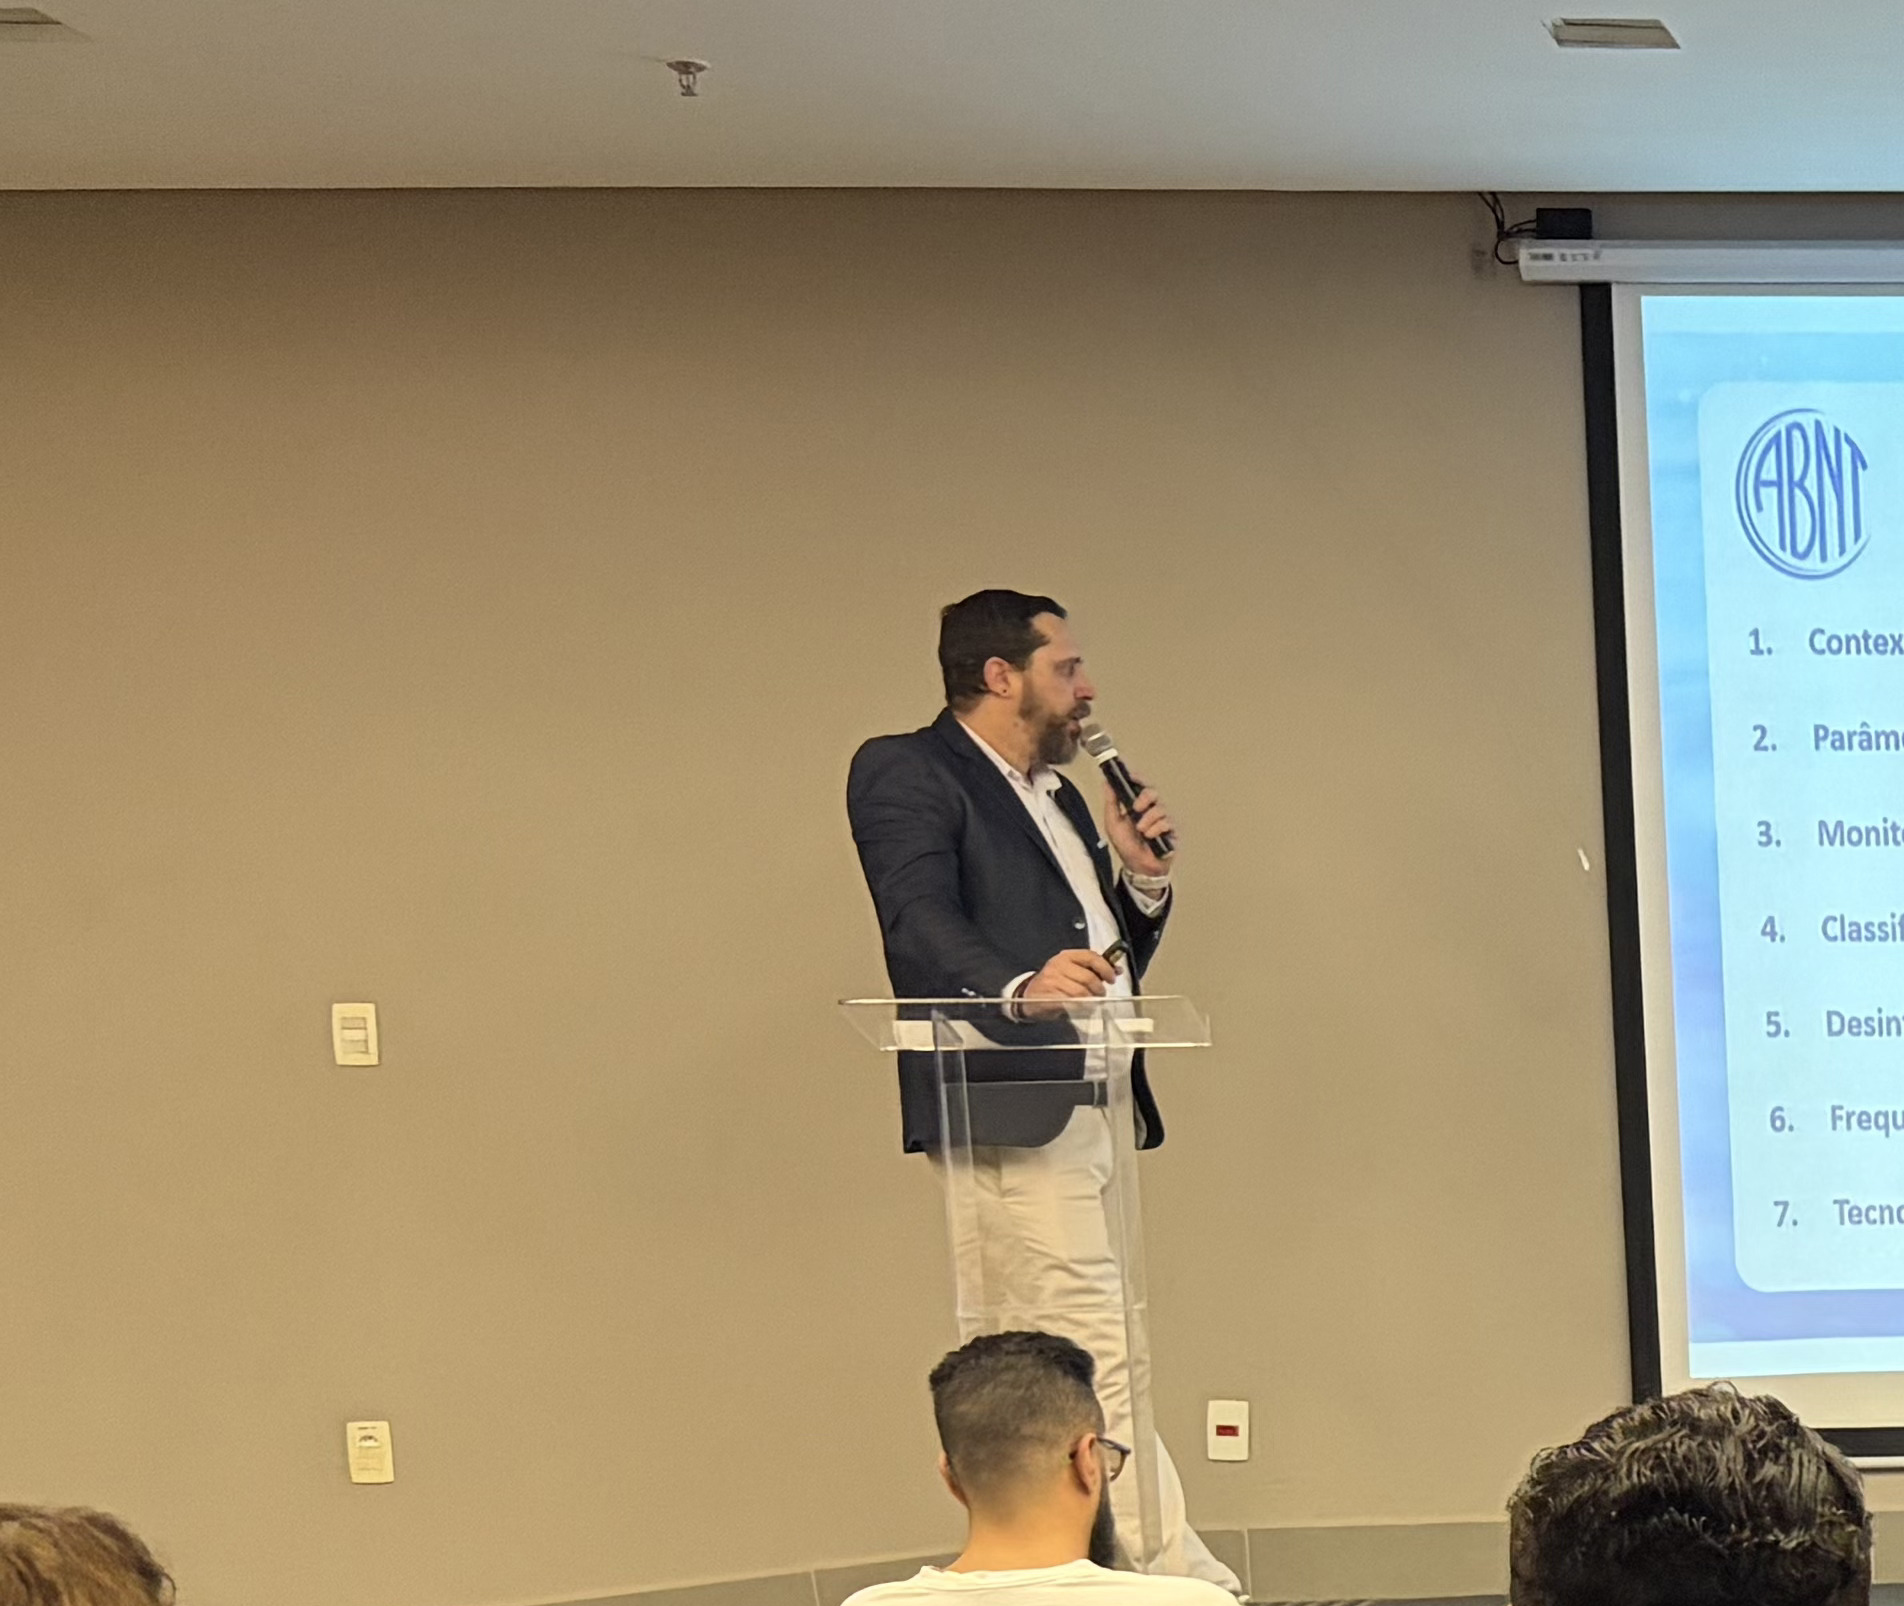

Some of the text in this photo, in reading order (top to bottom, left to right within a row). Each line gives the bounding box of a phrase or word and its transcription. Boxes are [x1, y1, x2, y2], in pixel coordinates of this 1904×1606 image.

[1754, 419, 1868, 562] ABNT
[1749, 627, 1773, 656] 1.
[1753, 724, 1777, 752] 2.
[1757, 820, 1781, 848] 3.
[1761, 916, 1785, 943] 4.
[1766, 1011, 1790, 1038] 5.
[1770, 1106, 1794, 1133] 6.
[1773, 1200, 1798, 1227] 7.
